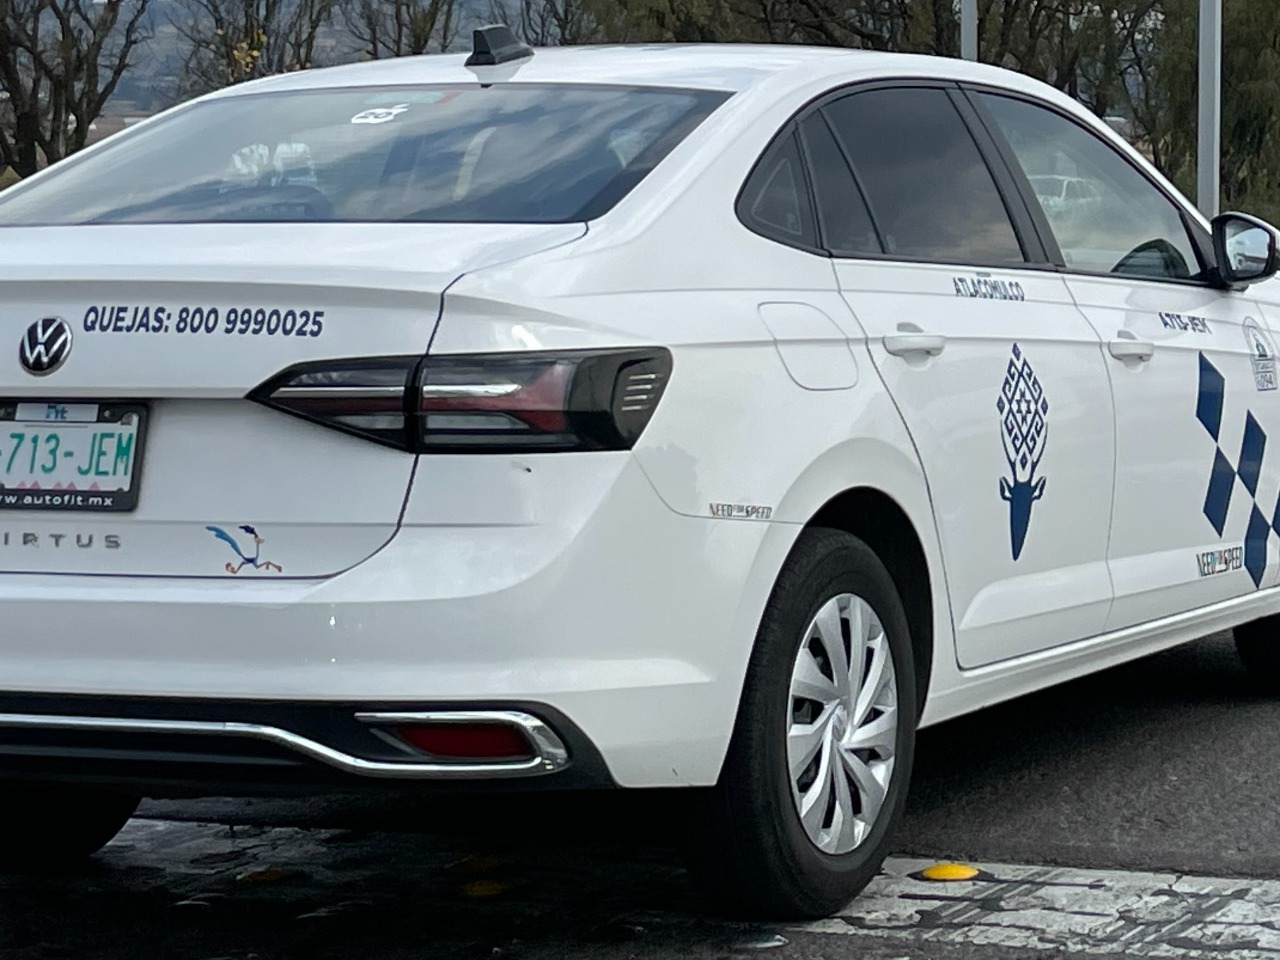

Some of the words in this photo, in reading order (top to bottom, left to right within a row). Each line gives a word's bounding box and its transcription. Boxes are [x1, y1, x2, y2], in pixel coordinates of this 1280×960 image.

[82, 305, 171, 334] QUEJAS:
[175, 306, 220, 334] 800
[224, 308, 325, 338] 9990025
[0, 431, 134, 477] 713-JEM
